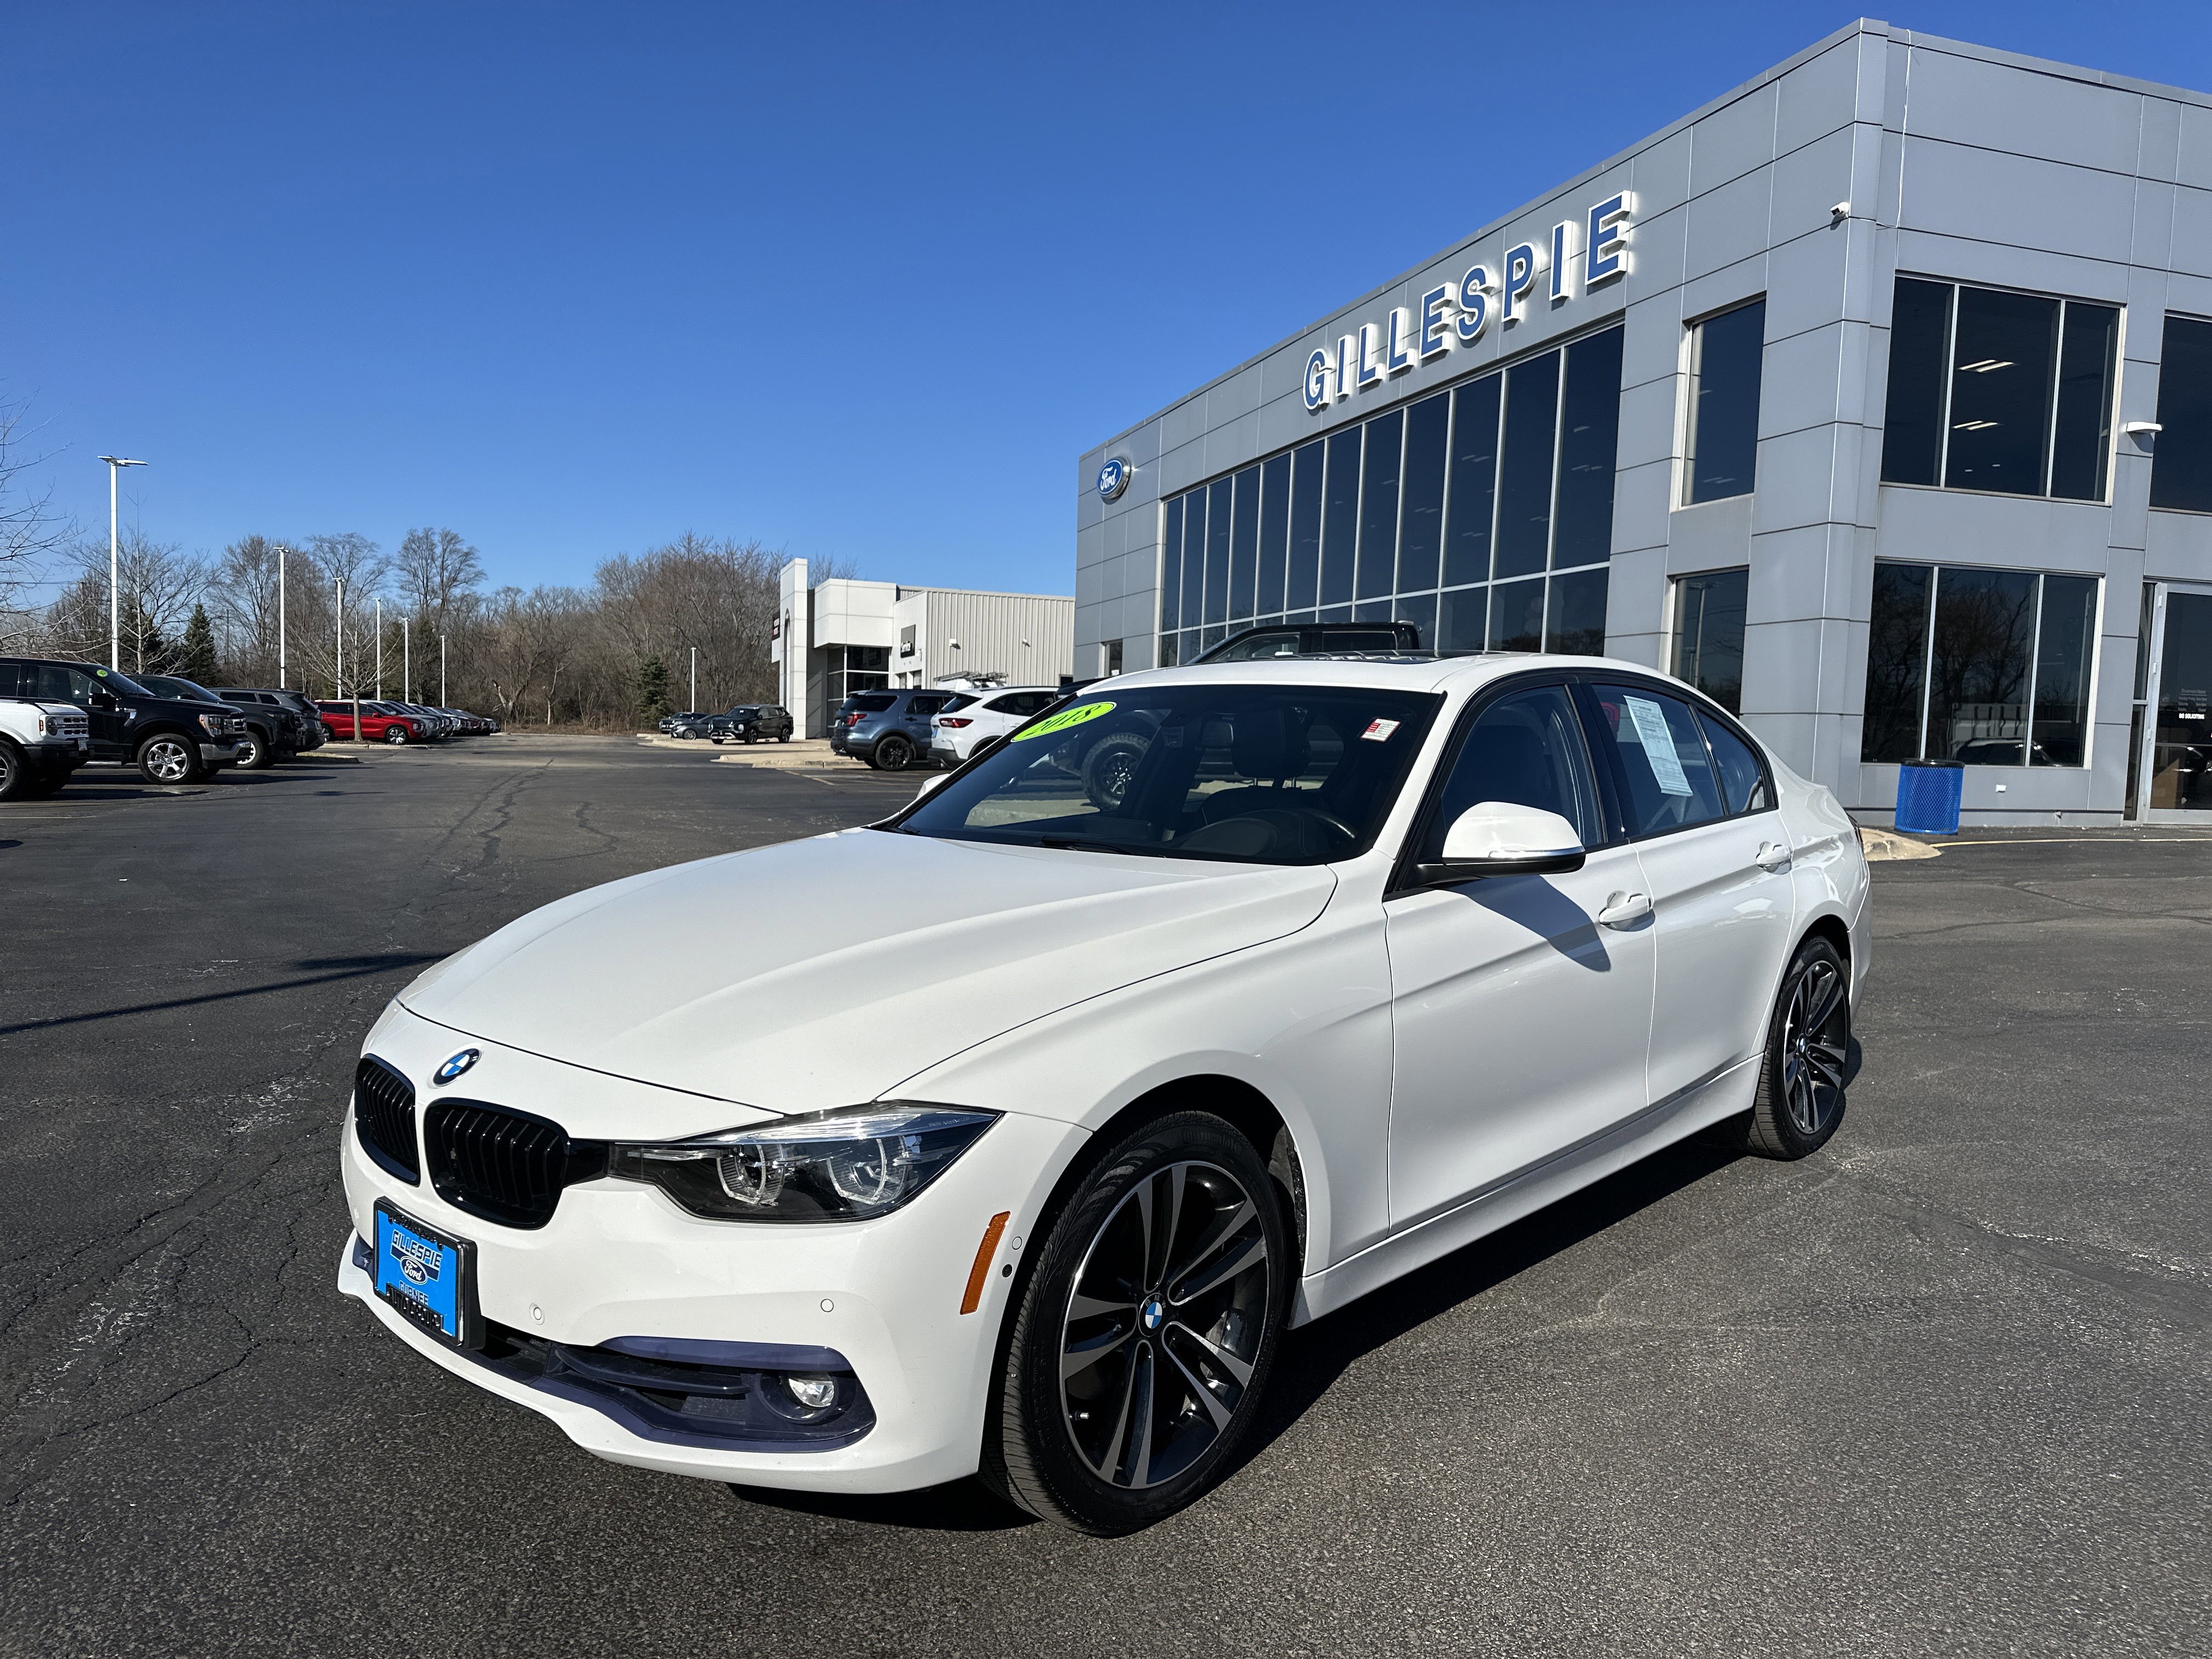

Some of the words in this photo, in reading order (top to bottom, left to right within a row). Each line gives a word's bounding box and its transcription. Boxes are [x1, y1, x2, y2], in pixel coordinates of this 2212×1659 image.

[1303, 190, 1630, 410] GILLESPIE
[1100, 466, 1118, 491] Ford
[1022, 705, 1102, 737] 2018
[392, 1230, 442, 1268] GILLESPIE
[404, 1260, 422, 1281] Ford
[399, 1280, 428, 1306] GURNEE
[1145, 1295, 1166, 1308] BMW
